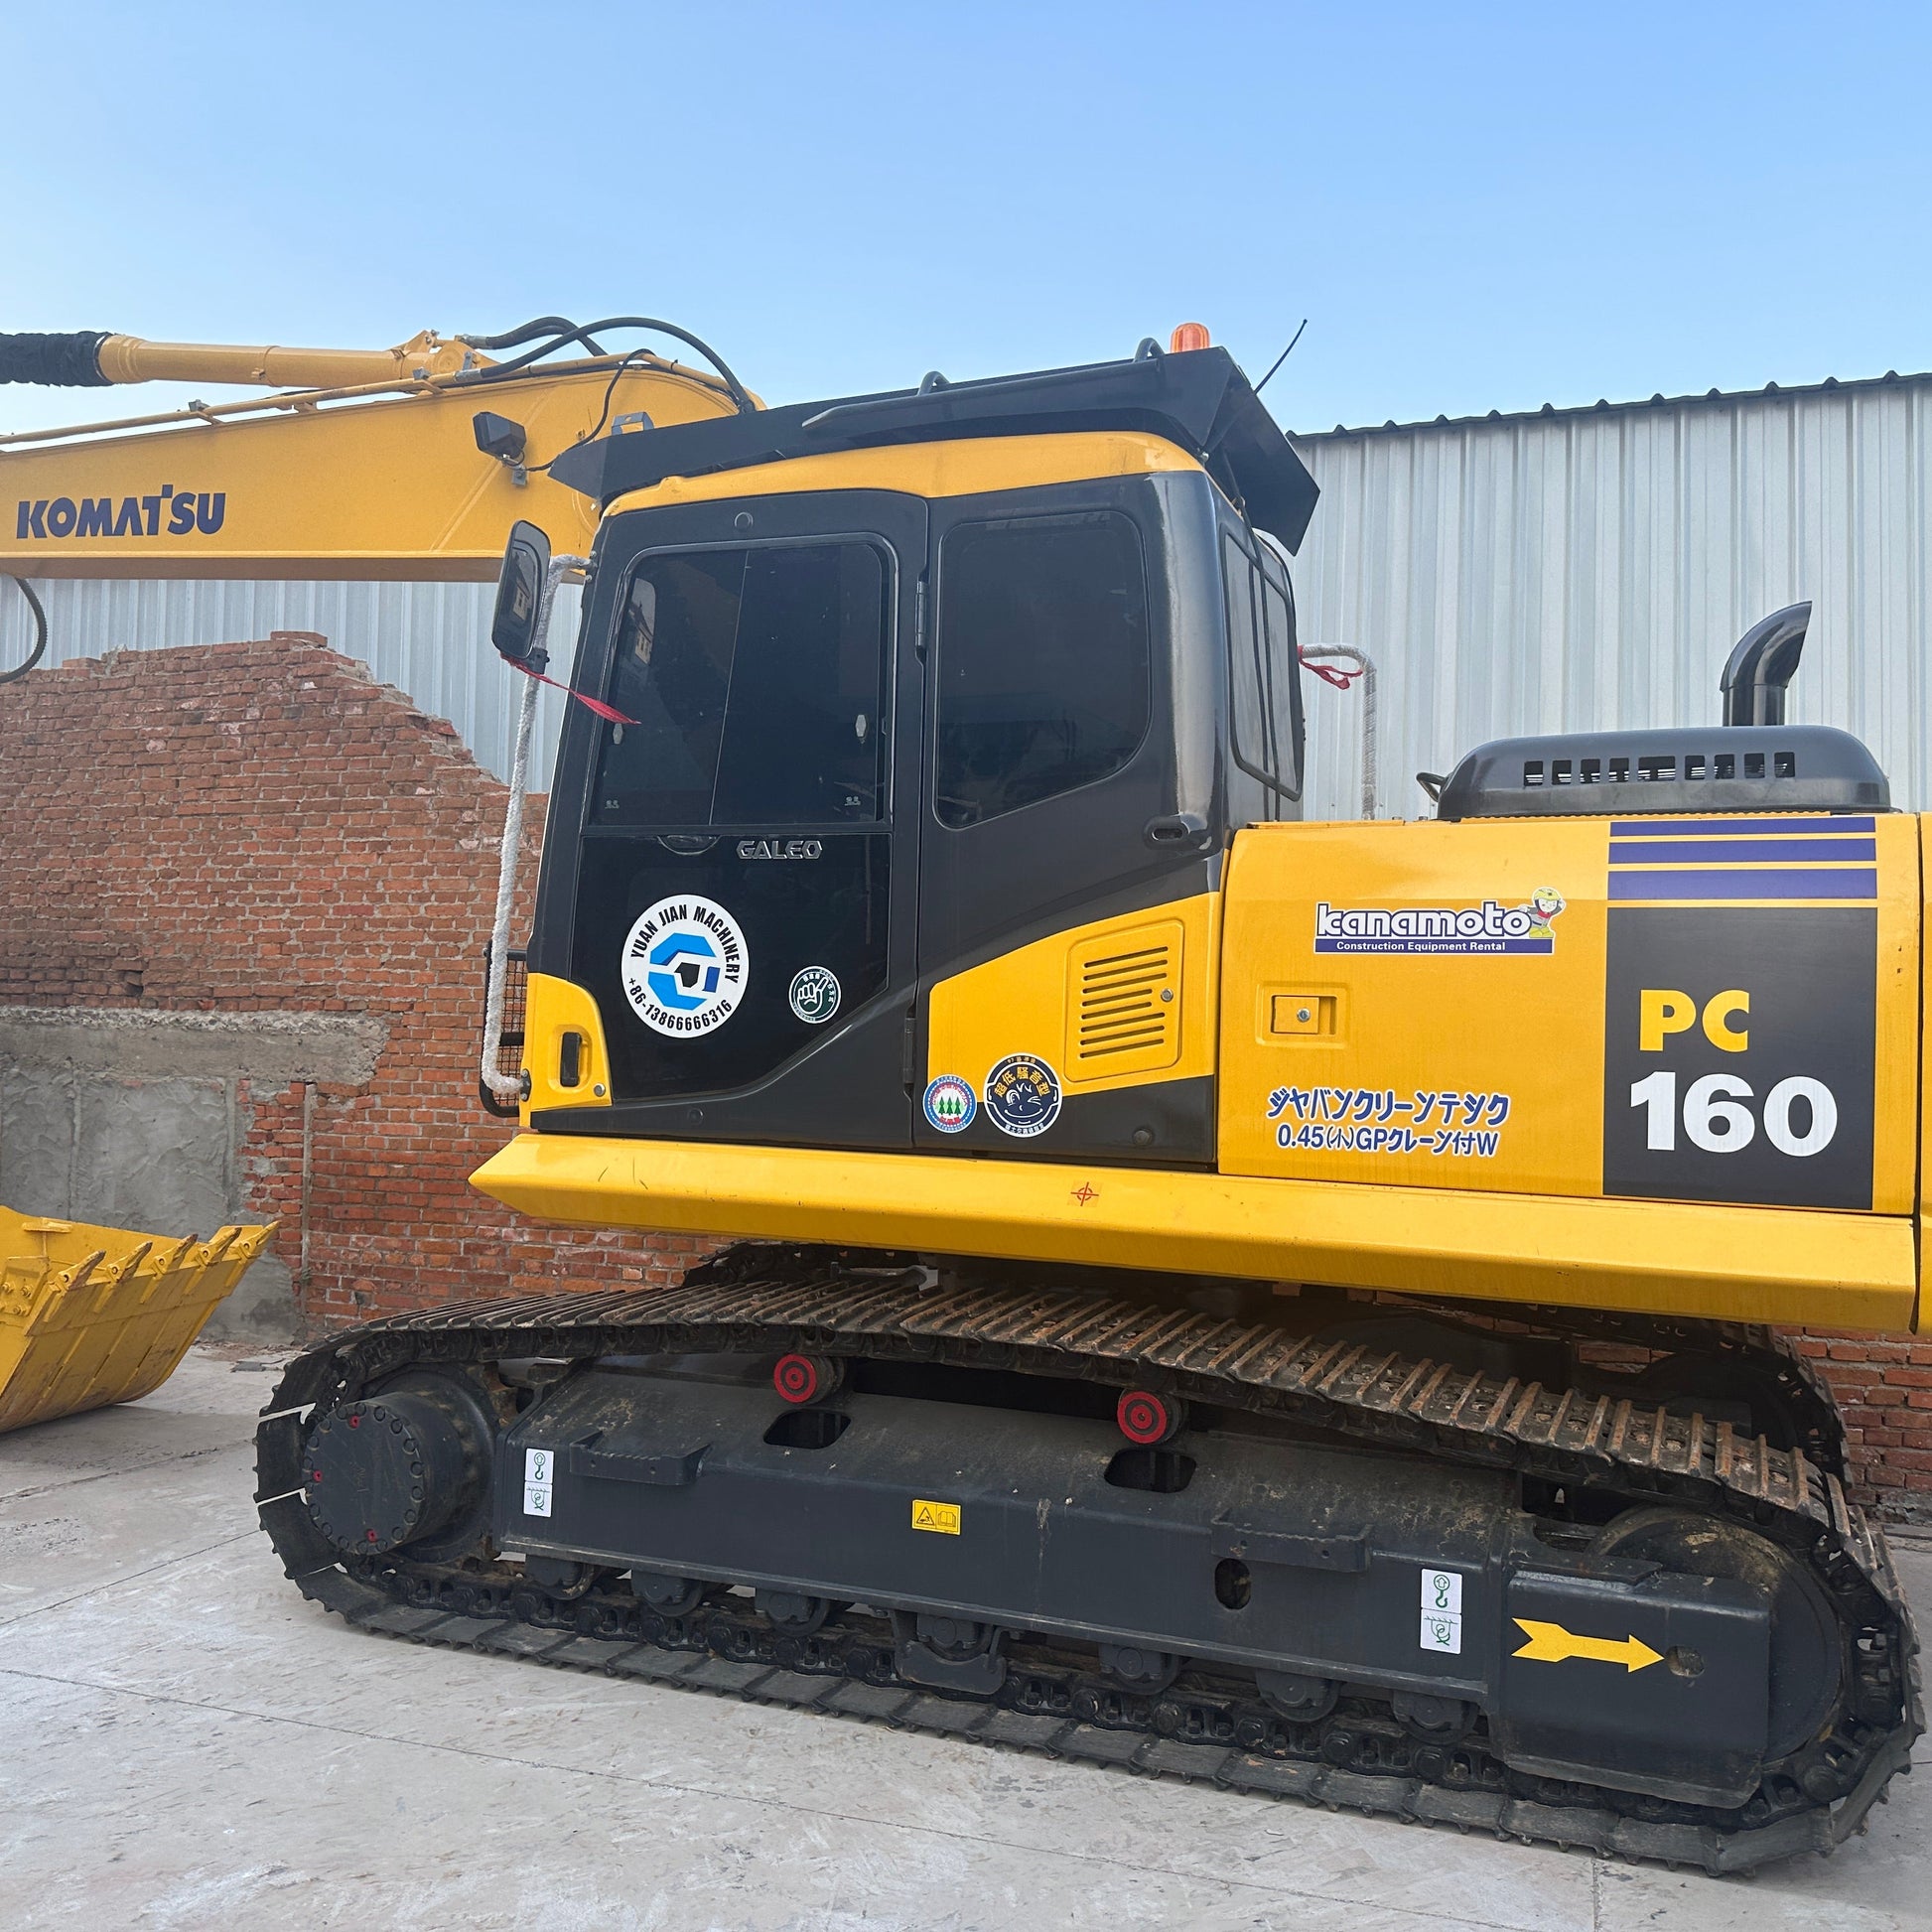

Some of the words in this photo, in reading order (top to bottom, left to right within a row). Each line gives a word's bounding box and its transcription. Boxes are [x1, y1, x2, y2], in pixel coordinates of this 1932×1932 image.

[17, 483, 226, 539] KOMATSU
[736, 840, 822, 860] GALEO
[630, 920, 658, 959] YUAN
[658, 904, 688, 926] JIAN
[693, 905, 741, 984] MACHINERY
[1316, 901, 1532, 937] kanamoto
[1336, 941, 1406, 951] Construction
[1408, 942, 1466, 952] Equipment
[1469, 942, 1505, 951] Rental
[628, 977, 733, 1031] +86-13866666316
[1639, 989, 1749, 1052] PC
[1630, 1071, 1838, 1157] 160
